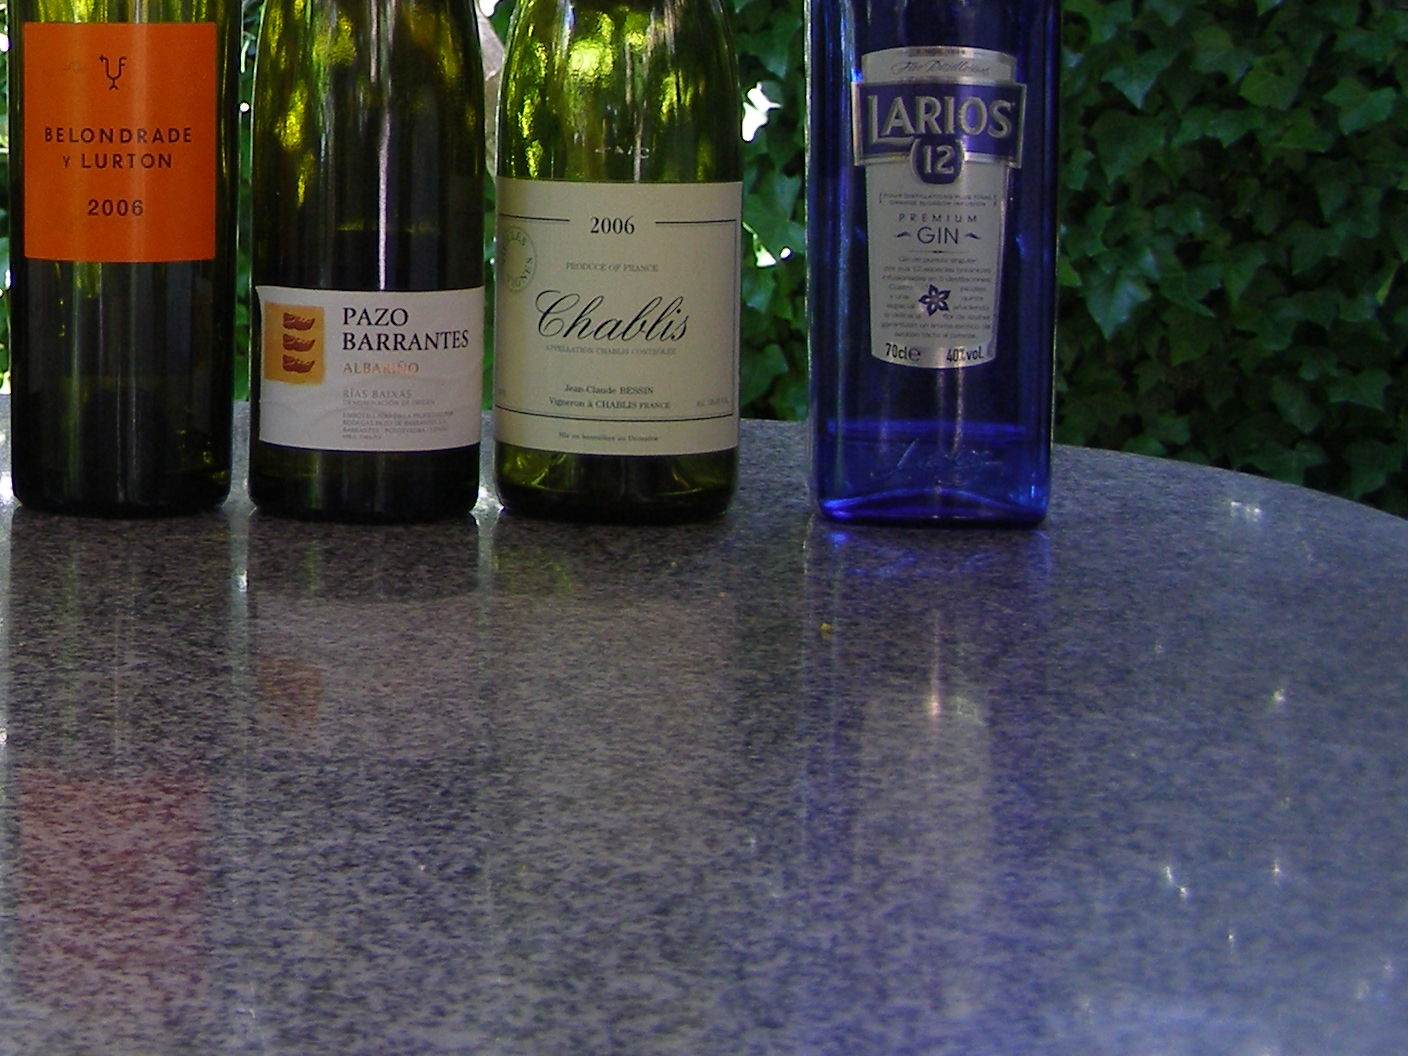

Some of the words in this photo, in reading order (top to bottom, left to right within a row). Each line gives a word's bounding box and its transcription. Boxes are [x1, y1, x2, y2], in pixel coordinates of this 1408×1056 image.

[867, 95, 1012, 144] LARIOS
[44, 127, 192, 143] BELONDRADE
[81, 153, 172, 169] LURTON
[923, 145, 955, 175] 12
[87, 199, 144, 217] 2006
[590, 215, 635, 235] 2006
[898, 214, 977, 223] PREMIUM
[917, 226, 959, 244] GIN
[343, 307, 409, 327] PAZO
[535, 289, 690, 342] Chablis
[342, 329, 470, 352] BARRANTES
